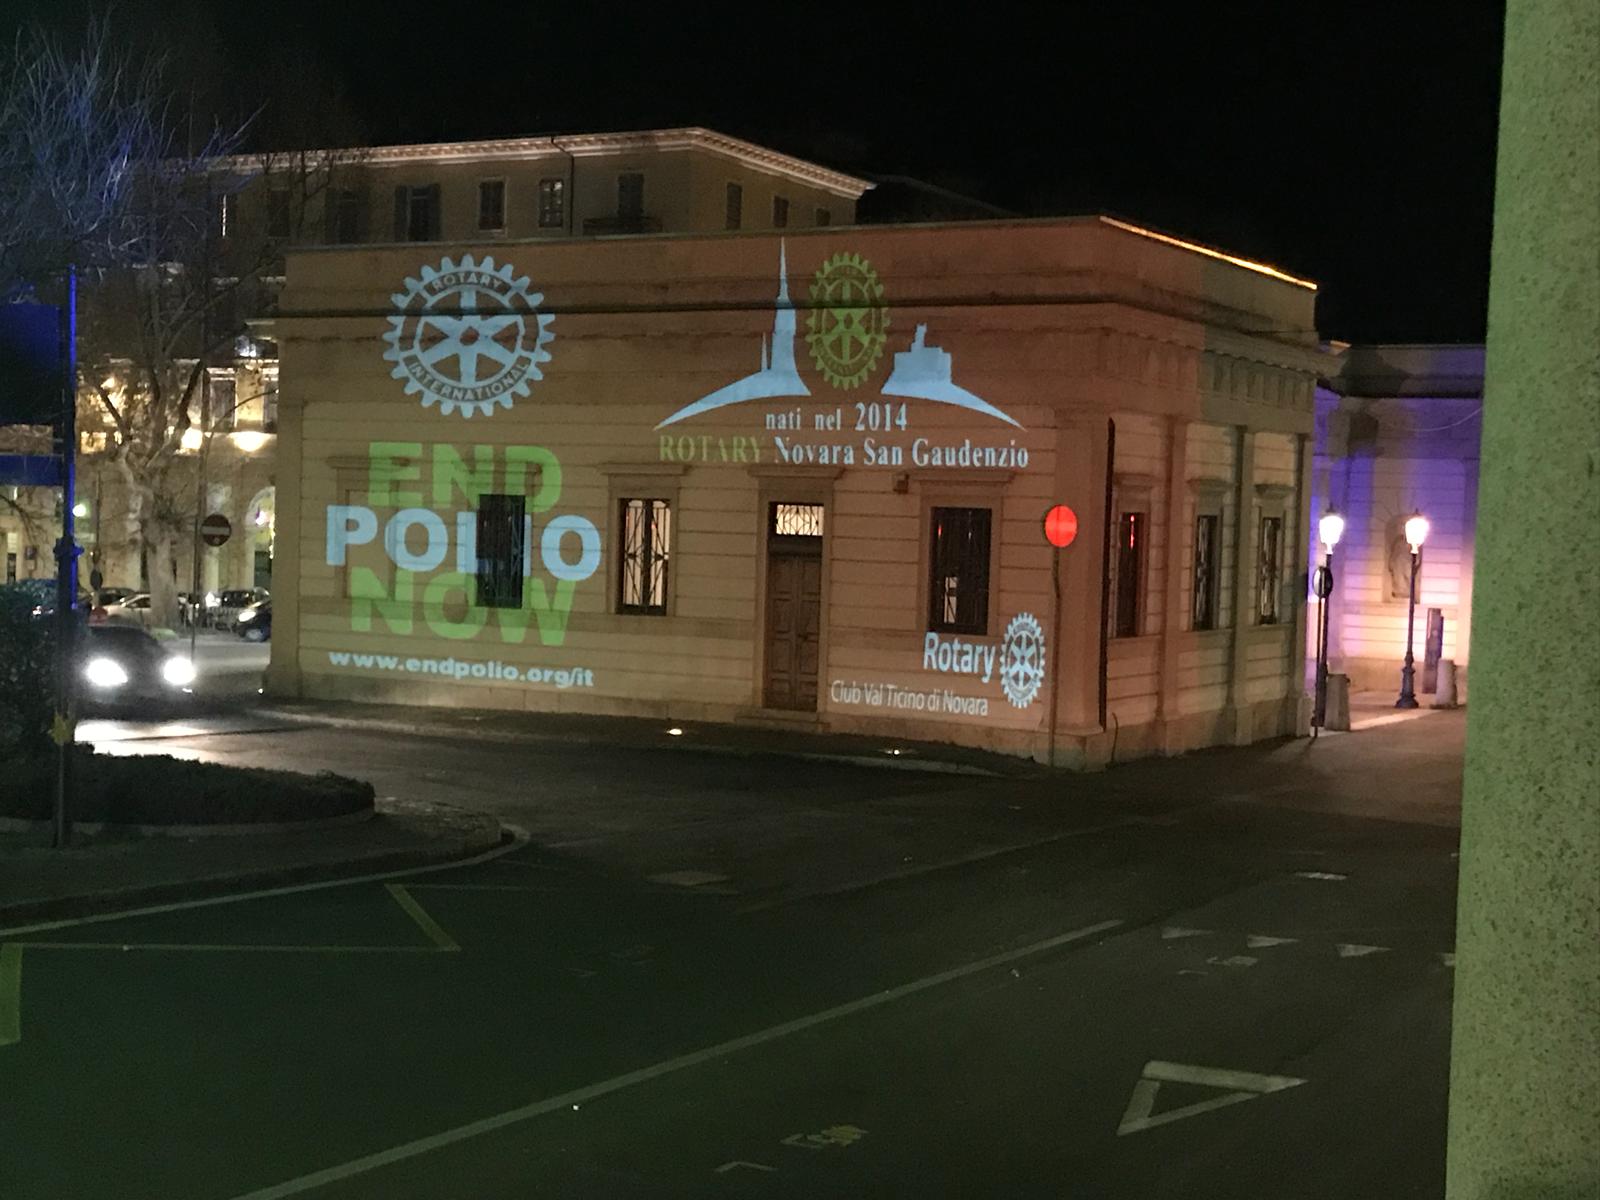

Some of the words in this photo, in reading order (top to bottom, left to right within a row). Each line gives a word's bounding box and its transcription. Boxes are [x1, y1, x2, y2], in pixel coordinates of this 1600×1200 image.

[433, 271, 502, 291] ROTARY
[409, 361, 530, 400] INTERNATIONAL
[766, 407, 801, 430] nati
[815, 408, 842, 431] nel
[855, 402, 908, 432] 2014
[659, 435, 765, 463] ROTARY
[774, 436, 854, 465] Novara
[863, 437, 903, 465] San
[912, 438, 1029, 468] Gaudenzio
[368, 441, 563, 513] END
[350, 566, 577, 646] NOW
[328, 651, 594, 689] www.endpolio.org/it
[923, 631, 996, 684] Rotary
[831, 680, 861, 704] Club
[864, 681, 883, 705] Val
[886, 684, 925, 711] Ticino
[928, 688, 940, 713] di
[943, 690, 989, 717] Novara
